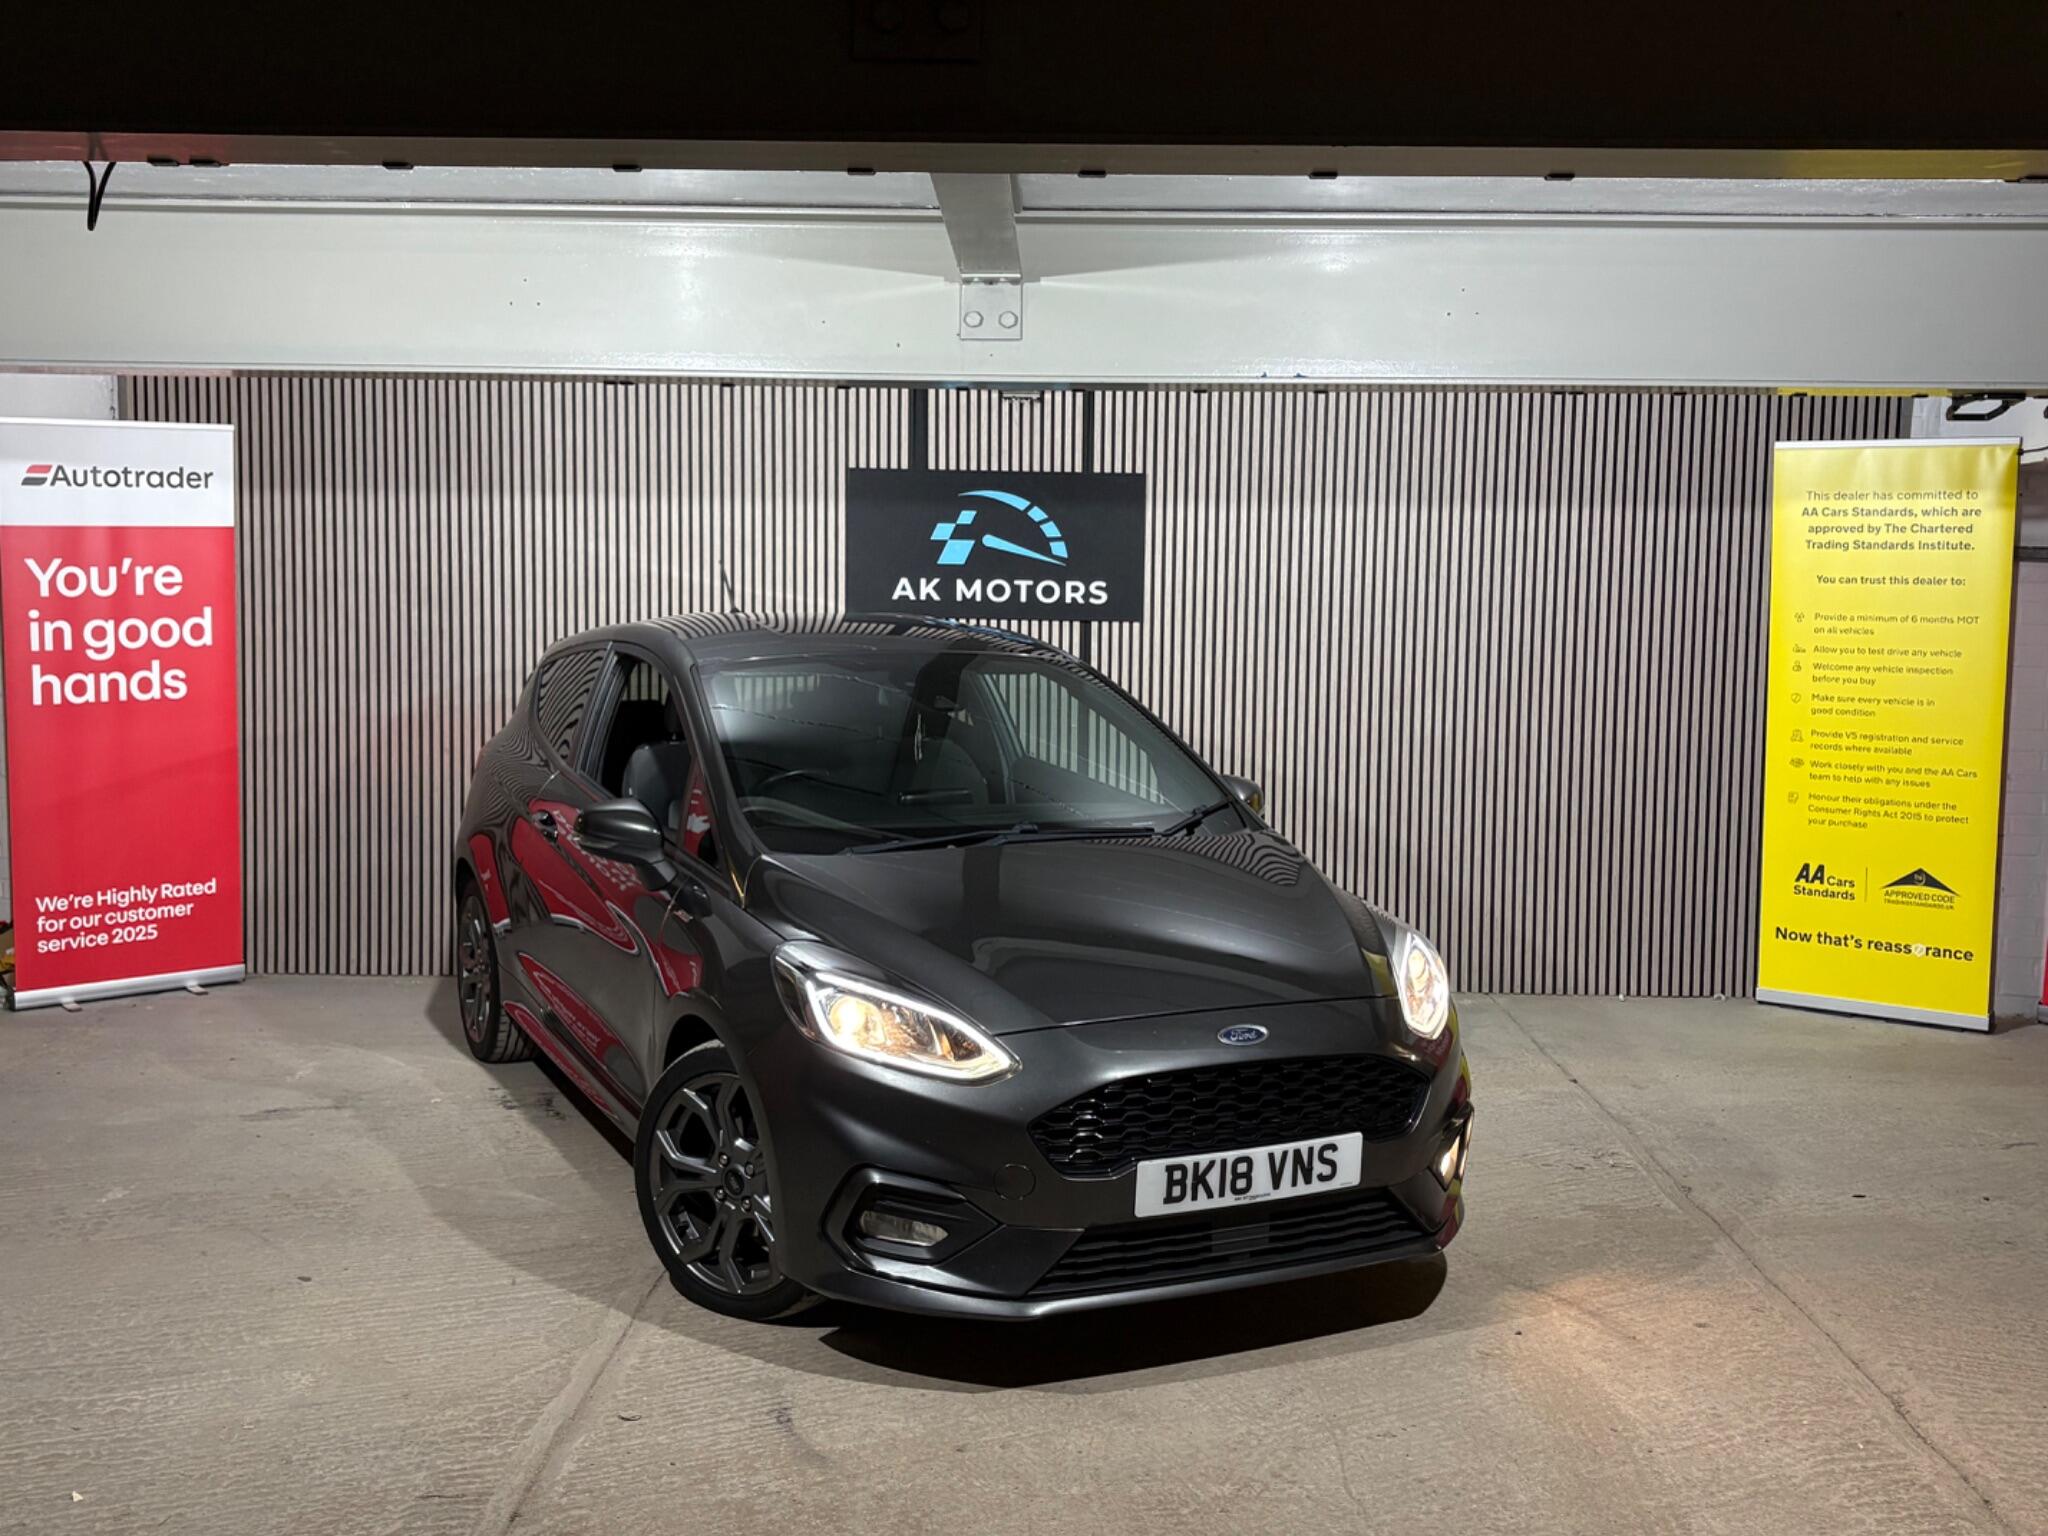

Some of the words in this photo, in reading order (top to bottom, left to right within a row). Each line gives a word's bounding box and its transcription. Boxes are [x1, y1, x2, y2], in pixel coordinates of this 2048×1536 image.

[50, 465, 213, 488] Autotrader
[1807, 491, 1830, 501] This
[1833, 490, 1869, 501] dealer
[1873, 490, 1893, 500] has
[1897, 490, 1963, 500] committed
[1966, 490, 1978, 500] to
[1802, 507, 1818, 517] AA
[1822, 507, 1849, 517] Cars
[1852, 507, 1918, 518] Standards,
[1921, 506, 1958, 517] which
[1962, 508, 1982, 517] are
[1808, 523, 1864, 535] approved
[1867, 523, 1881, 535] by
[1884, 523, 1907, 533] The
[1910, 523, 1973, 534] Chartered
[1805, 540, 1850, 551] Trading
[1853, 540, 1914, 550] Standards
[1918, 540, 1976, 551] Institute.
[1816, 575, 1836, 584] You
[1839, 576, 1858, 584] can
[1860, 576, 1886, 585] trust
[1889, 576, 1910, 585] this
[1912, 576, 1947, 586] dealer
[1950, 577, 1966, 586] to:
[892, 577, 941, 601] AK
[956, 579, 1108, 604] MOTORS
[1814, 612, 1847, 622] Provide
[1857, 614, 1898, 623] minimum
[1900, 614, 1909, 623] of
[1911, 615, 1918, 623] 6
[1920, 615, 1954, 624] months
[1957, 616, 1980, 624] MOT
[28, 610, 72, 652] in
[83, 606, 213, 661] good
[1827, 626, 1837, 635] all
[1840, 626, 1874, 636] vehicles
[1813, 645, 1837, 654] Allow
[1839, 647, 1855, 656] you
[1857, 647, 1866, 655] to
[1868, 647, 1885, 655] test
[1887, 647, 1909, 656] drive
[1911, 649, 1927, 658] any
[1930, 648, 1962, 658] vehicle
[1813, 662, 1853, 671] Welcome
[1856, 664, 1870, 673] any
[1873, 664, 1903, 674] vehicle
[1906, 665, 1953, 676] inspection
[31, 660, 187, 706] hands
[1812, 675, 1840, 684] before
[1842, 677, 1857, 686] you
[1860, 676, 1876, 686] buy
[1811, 693, 1834, 702] Make
[1837, 695, 1855, 703] sure
[1857, 696, 1881, 706] every
[1883, 696, 1915, 706] vehicle
[1917, 697, 1924, 706] is
[1926, 697, 1935, 706] in
[1811, 707, 1833, 717] good
[1835, 707, 1876, 717] condition
[1811, 730, 1843, 739] Provide
[1845, 731, 1857, 740] V5
[1860, 733, 1909, 743] registration
[1911, 735, 1928, 744] and
[1931, 736, 1964, 746] service
[1811, 742, 1843, 751] records
[1845, 743, 1871, 753] where
[1873, 745, 1912, 756] available
[1810, 760, 1832, 769] Work
[1834, 761, 1864, 772] closely
[1867, 763, 1885, 772] with
[1887, 766, 1903, 775] you
[1905, 765, 1922, 775] and
[1924, 766, 1938, 776] the
[1940, 768, 1954, 777] AA
[1956, 768, 1978, 778] Cars
[1809, 773, 1831, 781] team
[1832, 773, 1841, 782] to
[1843, 774, 1862, 784] help
[1864, 775, 1883, 784] with
[1885, 778, 1900, 787] any
[1903, 778, 1930, 788] issues
[1808, 793, 1840, 803] Honour
[1842, 794, 1862, 804] their
[1864, 796, 1912, 808] obligations
[1914, 799, 1940, 809] under
[1942, 801, 1957, 811] the
[1808, 805, 1851, 815] Consumer
[1854, 807, 1881, 818] Rights
[1883, 810, 1898, 819] Act
[1900, 811, 1922, 820] 2015
[1924, 813, 1934, 821] to
[1936, 814, 1969, 824] protect
[1807, 818, 1825, 826] your
[1828, 819, 1868, 829] purchase
[1795, 863, 1825, 884] AA
[1827, 876, 1855, 888] Cars
[97, 885, 157, 907] Highly
[161, 878, 216, 899] Rated
[1793, 885, 1856, 900] Standards
[37, 916, 64, 933] for
[70, 913, 102, 930] our
[104, 901, 194, 925] customer
[37, 930, 108, 953] service
[112, 924, 158, 944] 2025
[1775, 926, 1812, 942] Now
[1867, 939, 1974, 961] reassrance
[1230, 1028, 1257, 1042] Ford
[1163, 1156, 1253, 1205] BK18
[1268, 1143, 1338, 1190] VNS
